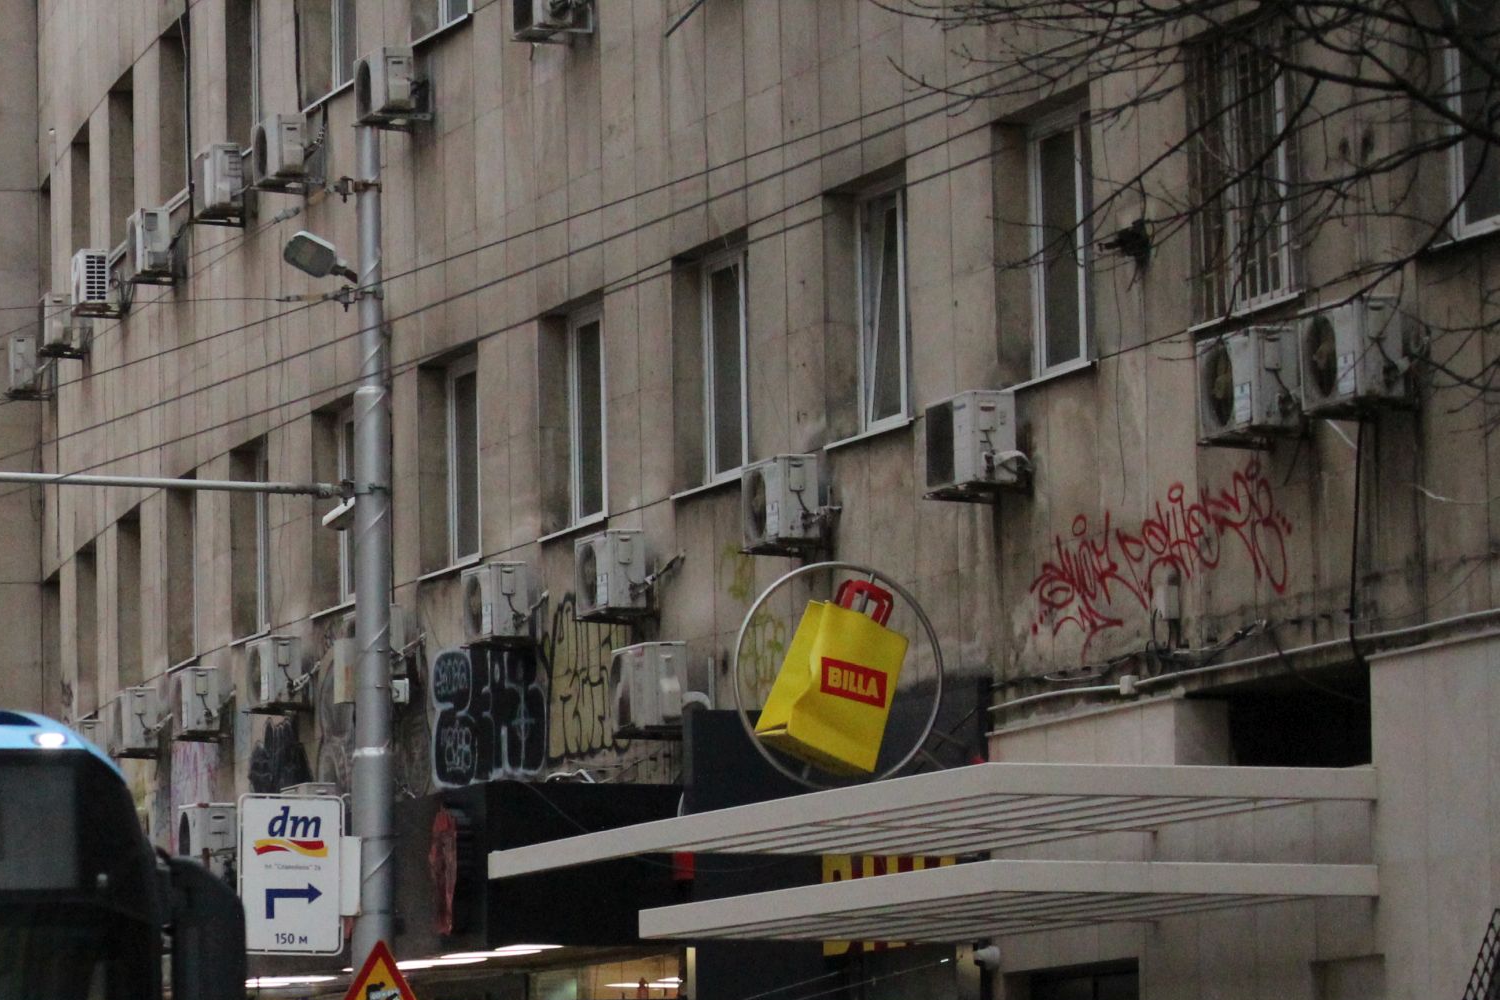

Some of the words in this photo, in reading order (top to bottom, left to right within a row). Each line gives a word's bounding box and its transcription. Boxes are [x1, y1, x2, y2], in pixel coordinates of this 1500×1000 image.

[828, 665, 880, 699] BILLA
[268, 805, 322, 838] dm
[275, 933, 296, 945] 150
